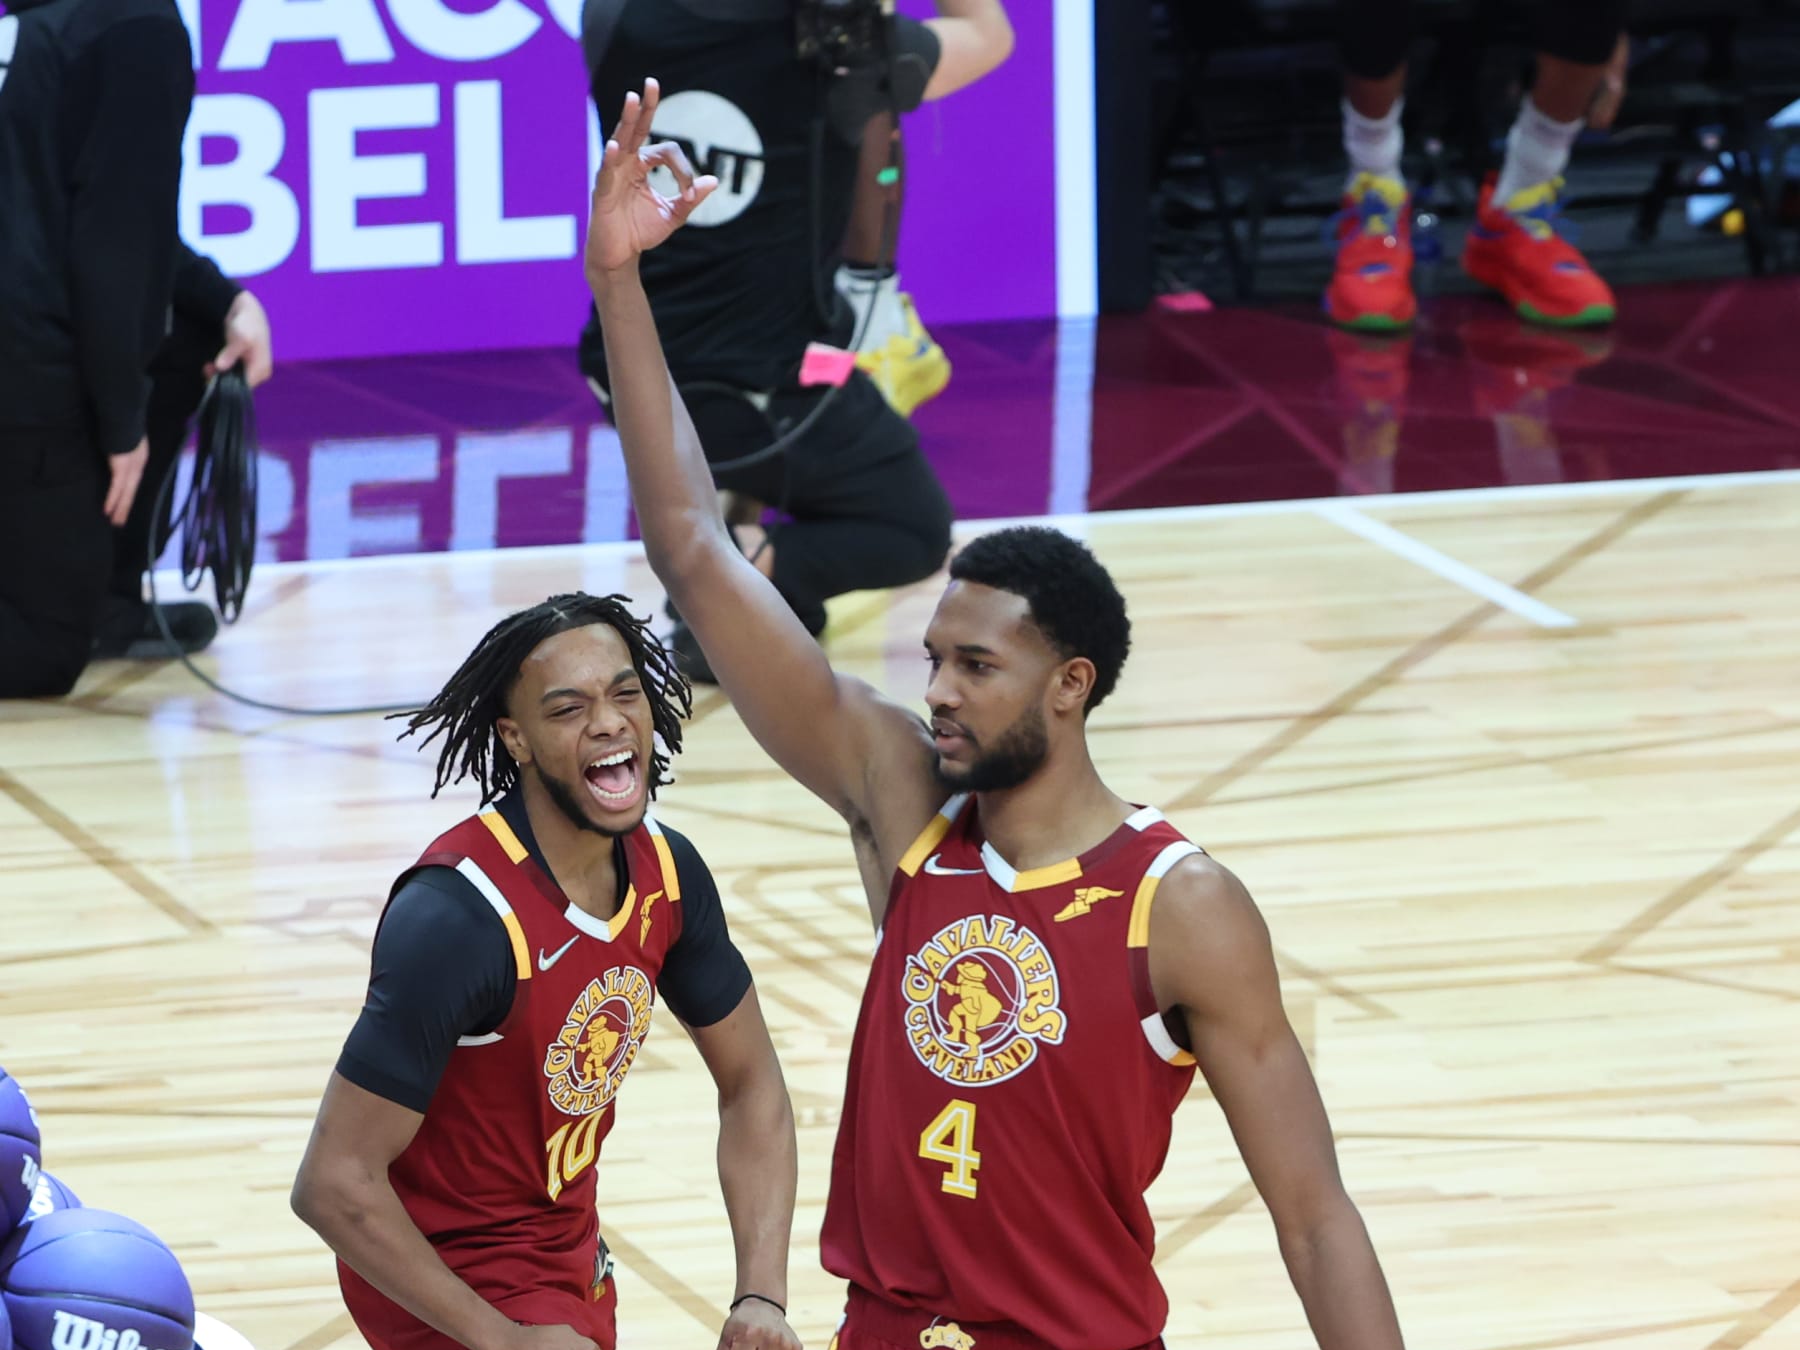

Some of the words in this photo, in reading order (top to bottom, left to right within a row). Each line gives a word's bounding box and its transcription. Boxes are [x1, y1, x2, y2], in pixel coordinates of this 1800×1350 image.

[544, 966, 652, 1077] CAVALIERS
[902, 914, 1067, 1045] CAVALIERS
[548, 1041, 640, 1115] CLEVELAND
[904, 1004, 1038, 1088] CLEVELAND
[546, 1107, 608, 1202] 10
[918, 1098, 981, 1199] 4
